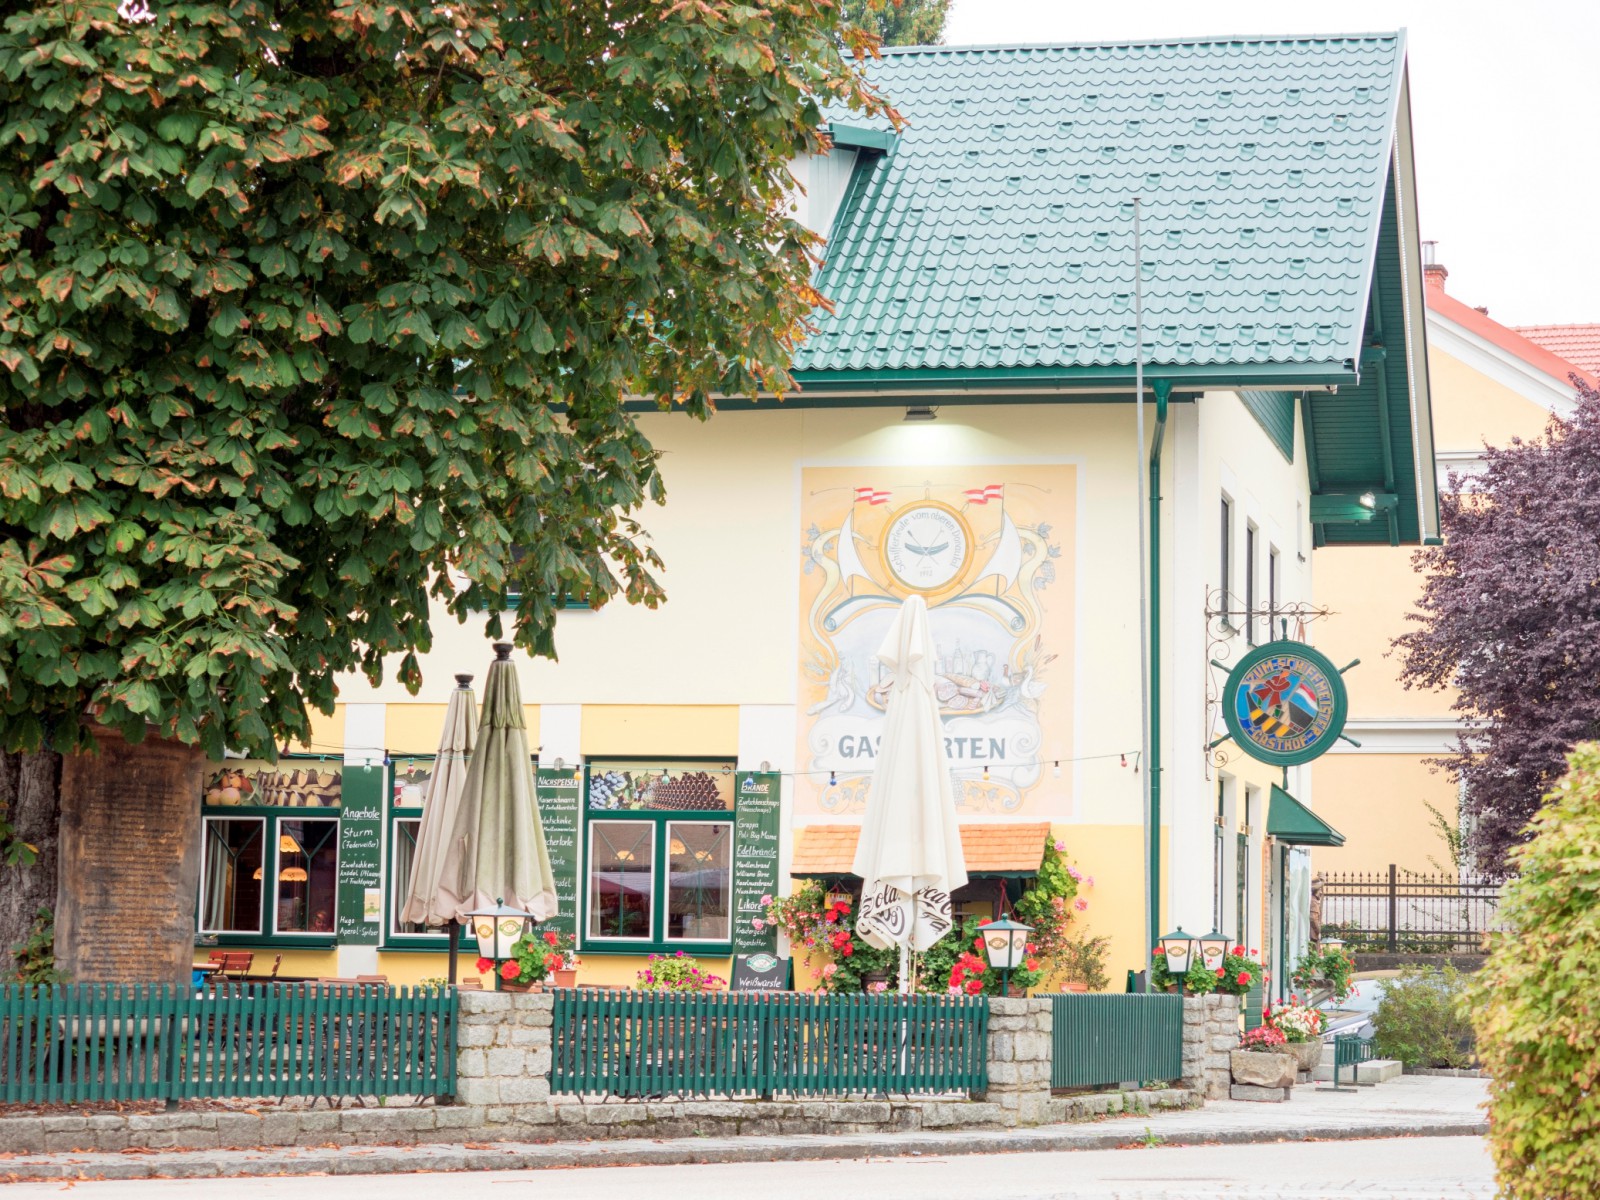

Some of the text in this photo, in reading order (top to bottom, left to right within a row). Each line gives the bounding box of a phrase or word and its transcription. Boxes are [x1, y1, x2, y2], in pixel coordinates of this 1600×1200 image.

[911, 512, 930, 521] vom
[930, 511, 956, 531] oberen
[1252, 729, 1308, 751] GASTHOF
[342, 806, 380, 821] Angebote
[343, 827, 374, 839] Sturm
